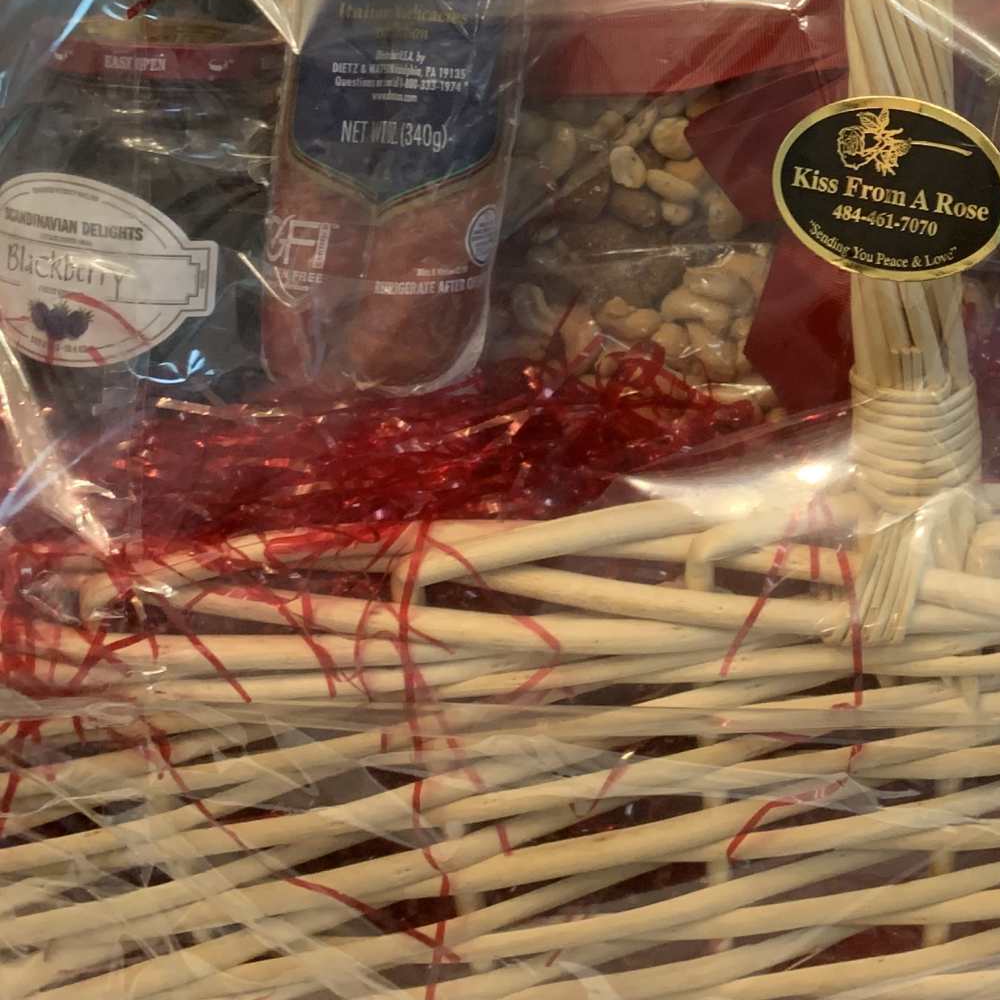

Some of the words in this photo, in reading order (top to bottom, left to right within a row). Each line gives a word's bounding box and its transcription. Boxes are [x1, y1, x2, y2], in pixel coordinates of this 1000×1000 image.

[341, 120, 368, 144] NET
[400, 122, 448, 152] (340g)
[791, 166, 839, 194] Kiss
[843, 175, 906, 207] From
[910, 189, 929, 212] A
[935, 192, 990, 222] Rose
[4, 206, 78, 235] SCANDINAVIAN
[81, 221, 144, 241] DELIGHTS
[832, 204, 938, 237] 484-461-7070
[853, 246, 874, 264] You
[876, 255, 909, 268] Peace
[911, 256, 922, 268] &
